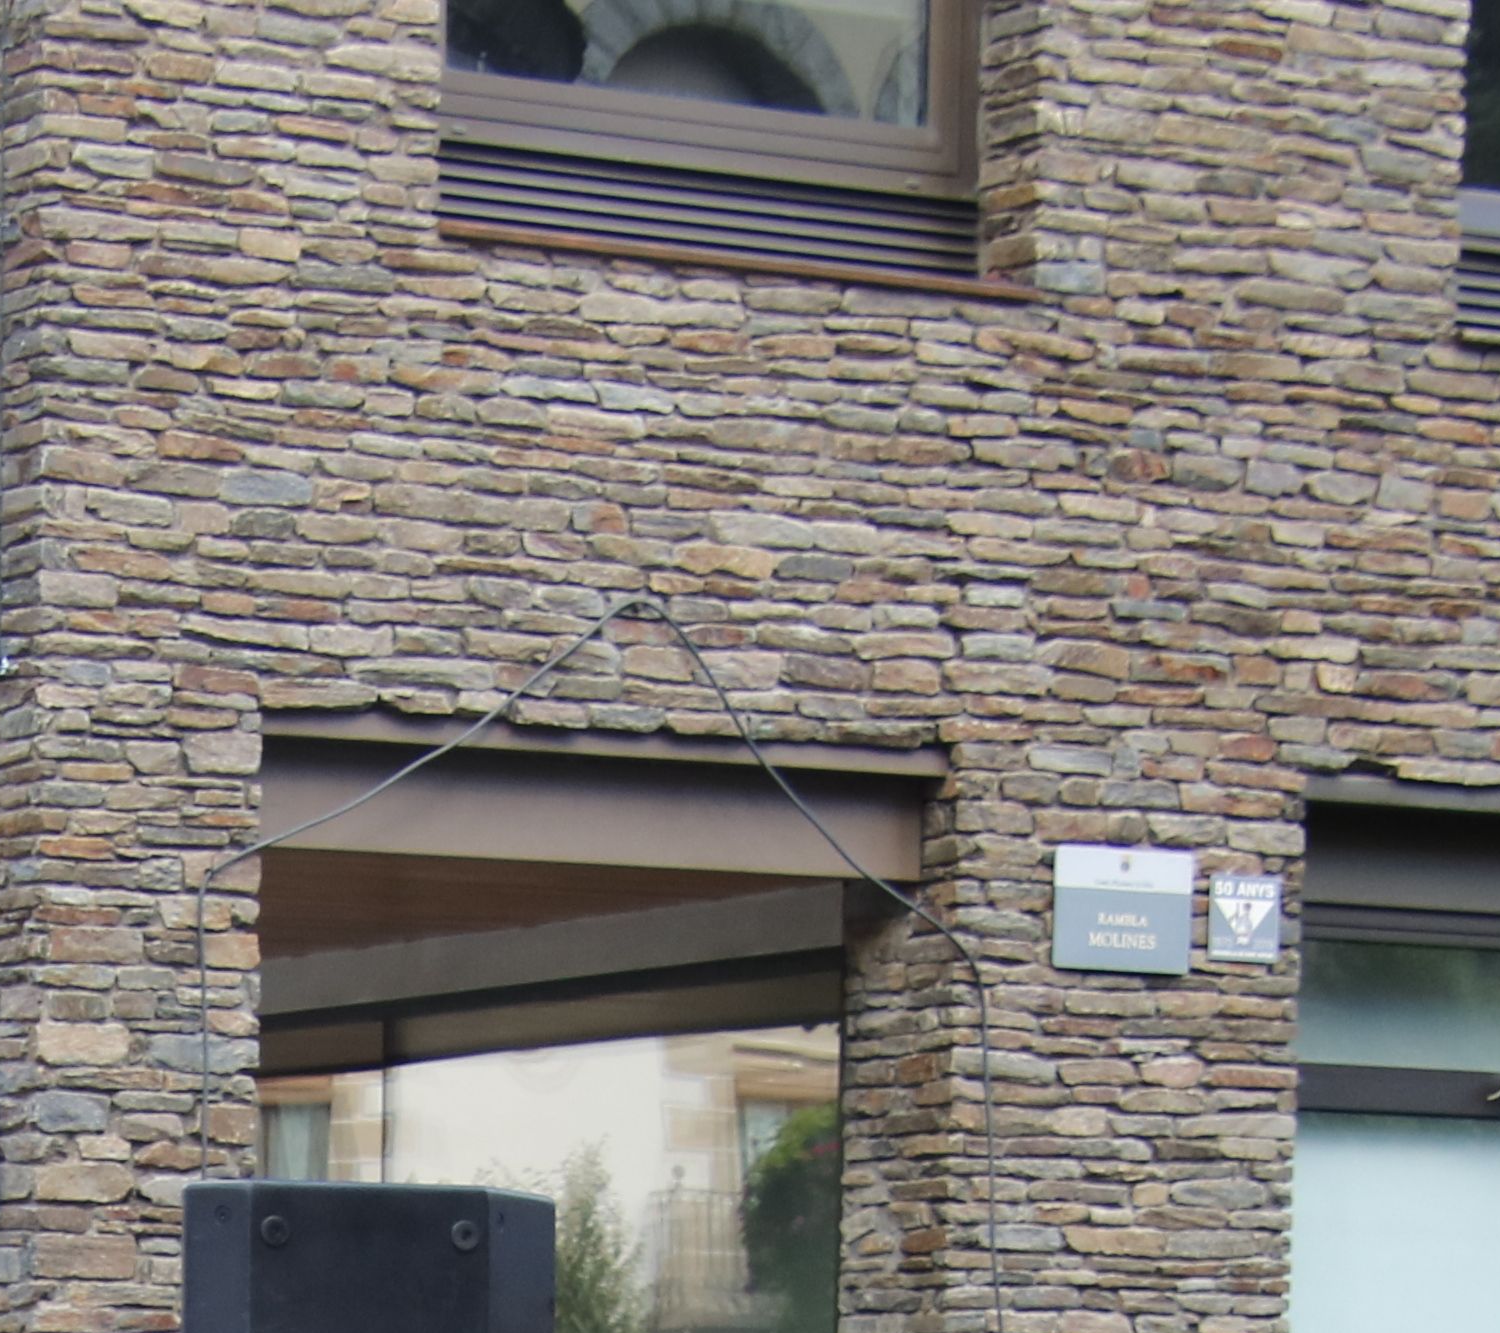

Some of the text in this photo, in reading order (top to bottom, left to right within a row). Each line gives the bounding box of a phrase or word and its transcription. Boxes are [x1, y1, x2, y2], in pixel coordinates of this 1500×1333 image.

[1214, 880, 1275, 899] 50 ANYS
[1097, 912, 1148, 928] RAMBLA
[1088, 931, 1157, 950] MOLINES
